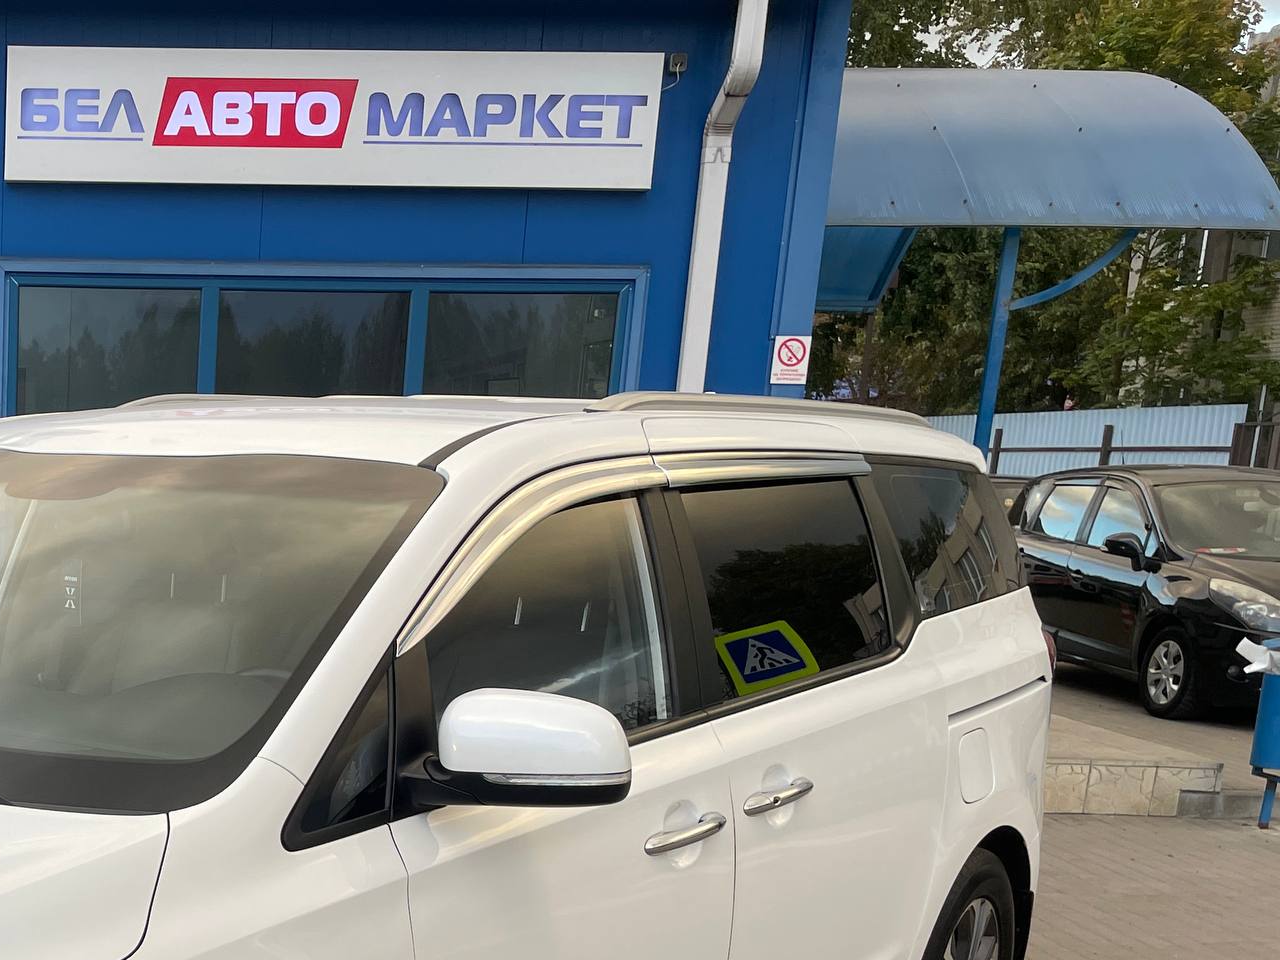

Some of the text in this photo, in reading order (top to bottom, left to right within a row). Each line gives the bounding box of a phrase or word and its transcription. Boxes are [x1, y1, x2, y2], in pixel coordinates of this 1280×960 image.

[20, 87, 649, 139] БЕЛ АВТО МАРКЕТ
